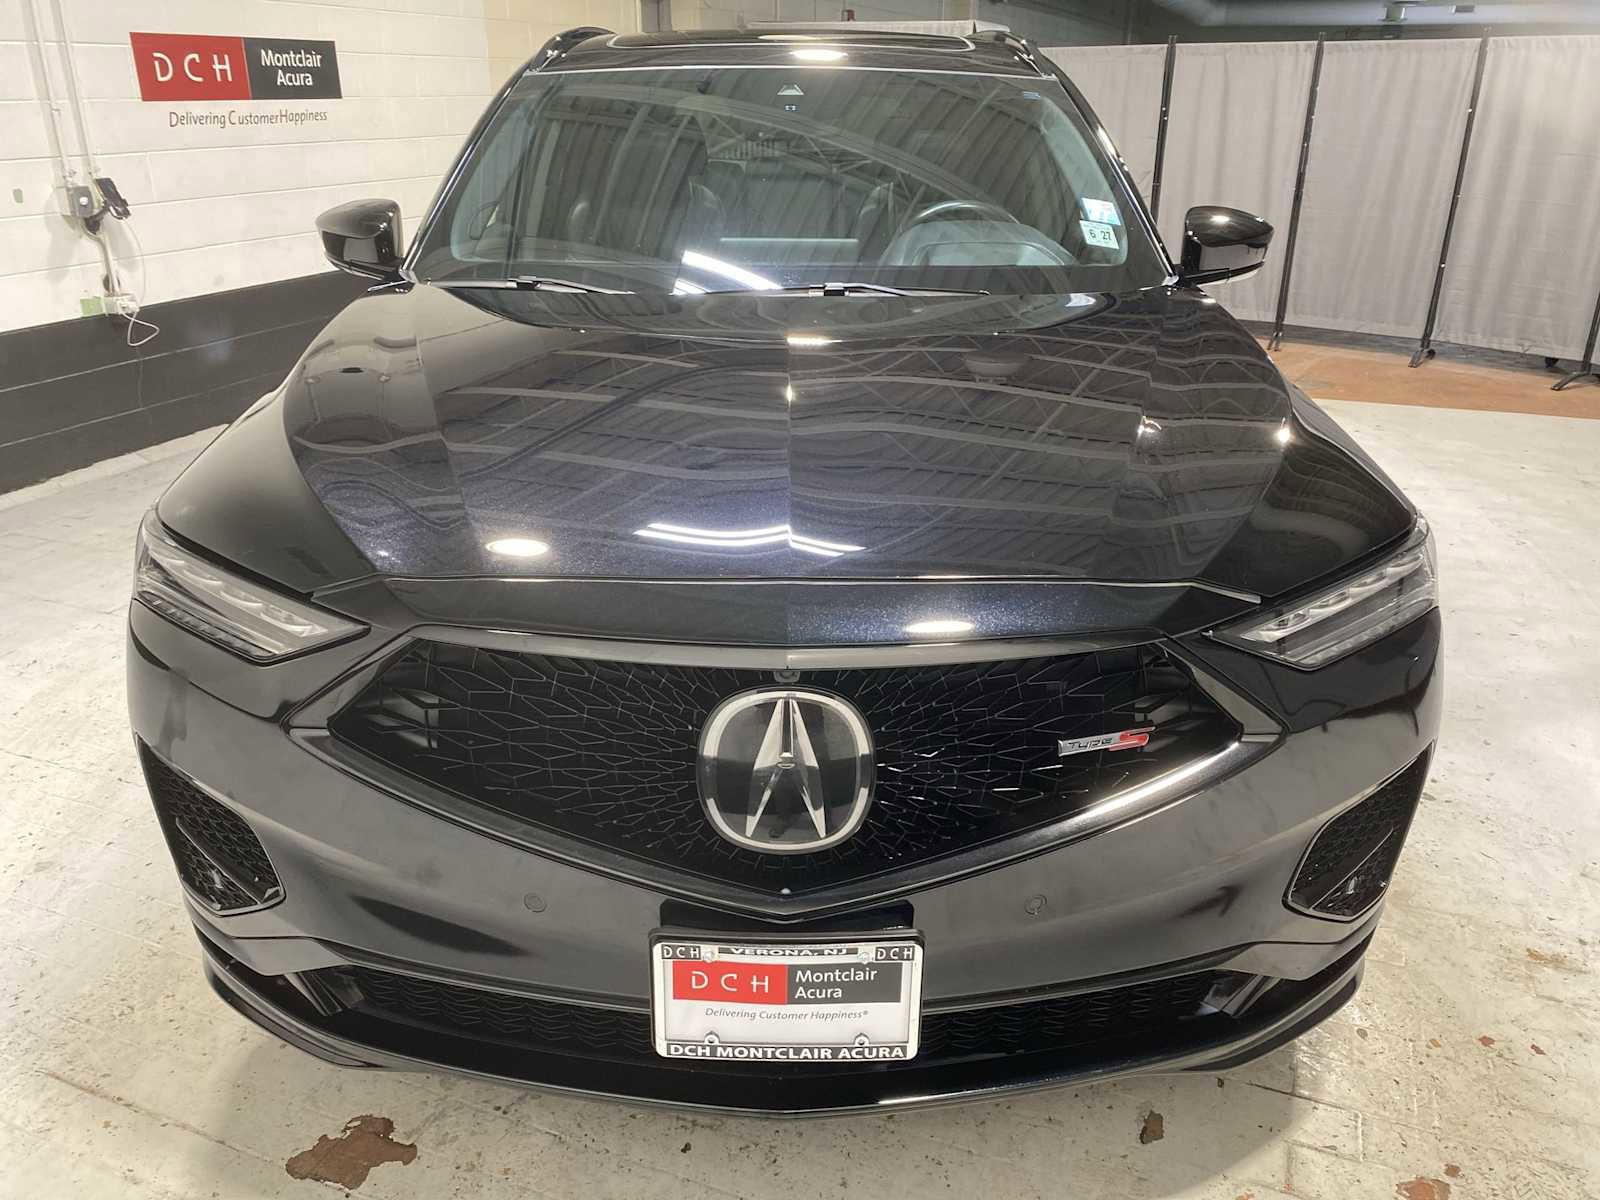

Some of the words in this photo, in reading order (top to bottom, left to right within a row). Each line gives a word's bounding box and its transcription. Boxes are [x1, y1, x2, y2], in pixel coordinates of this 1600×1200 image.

[260, 48, 322, 68] Montclair
[152, 52, 233, 82] DCH
[277, 70, 313, 86] Acura
[169, 111, 226, 129] Delivering
[228, 110, 280, 126] Customer
[280, 109, 328, 125] Happiness
[1109, 726, 1156, 752] S
[663, 946, 700, 959] DCH
[731, 948, 818, 956] VERONA,
[823, 948, 848, 956] NJ
[876, 947, 913, 960] DCH
[691, 970, 769, 993] DCH
[795, 967, 878, 983] Montclair
[794, 986, 843, 999] Acura
[705, 1007, 756, 1021] Delivering
[759, 1011, 809, 1020] Customer
[670, 1044, 711, 1057] DCH
[716, 1046, 833, 1060] MONTCLAIR
[838, 1046, 904, 1060] ACURA
